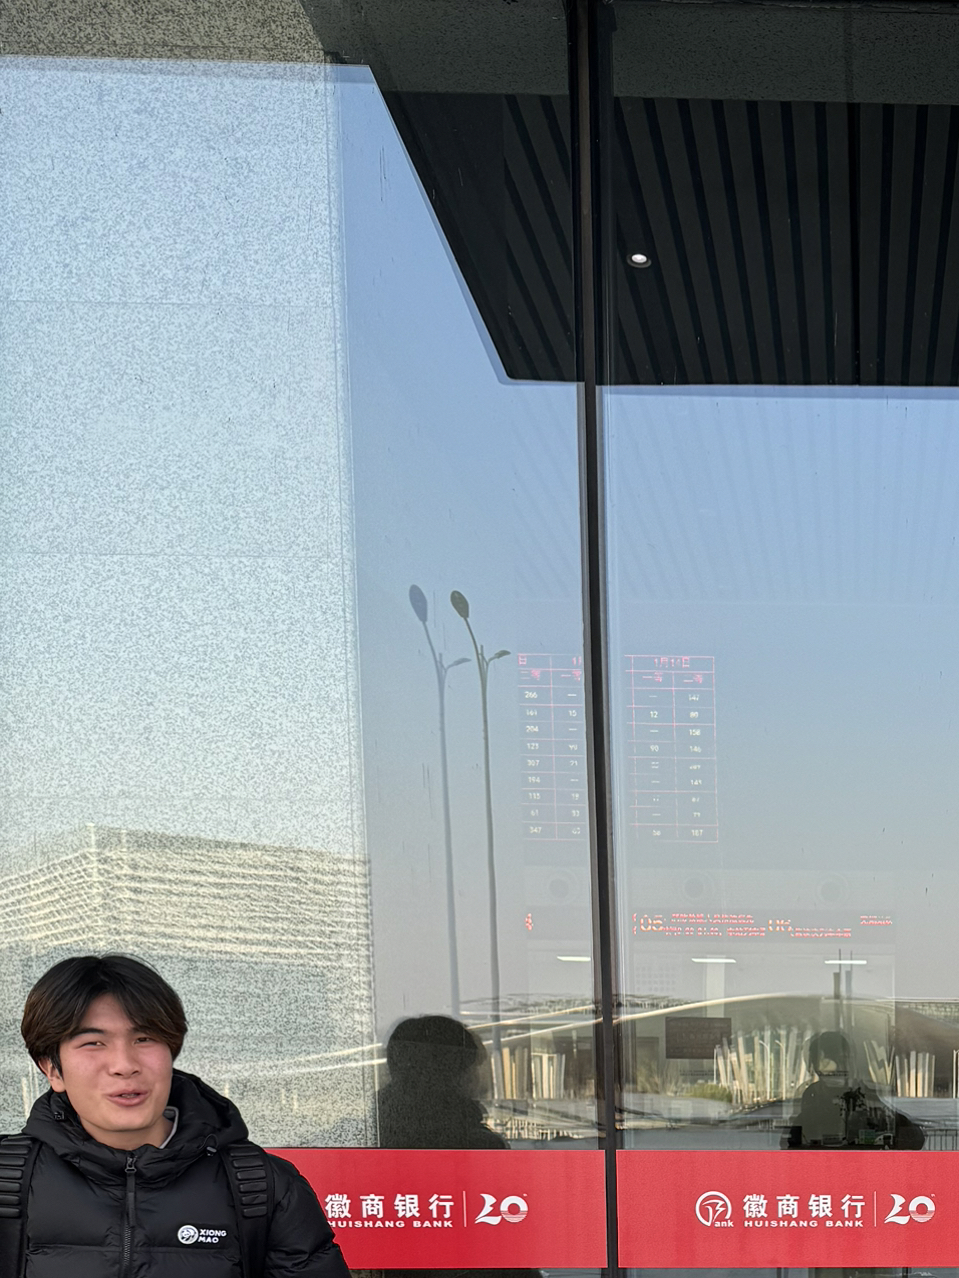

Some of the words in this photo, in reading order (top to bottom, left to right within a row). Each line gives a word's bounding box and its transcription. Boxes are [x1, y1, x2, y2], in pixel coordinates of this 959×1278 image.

[325, 1193, 454, 1219] 徽商银行
[743, 1194, 865, 1218] 徽商银行
[327, 1220, 405, 1228] HUISHANG
[413, 1220, 453, 1228] BANK
[744, 1220, 818, 1228] HUISHANG
[826, 1220, 864, 1228] BANK
[200, 1229, 227, 1237] XIONG
